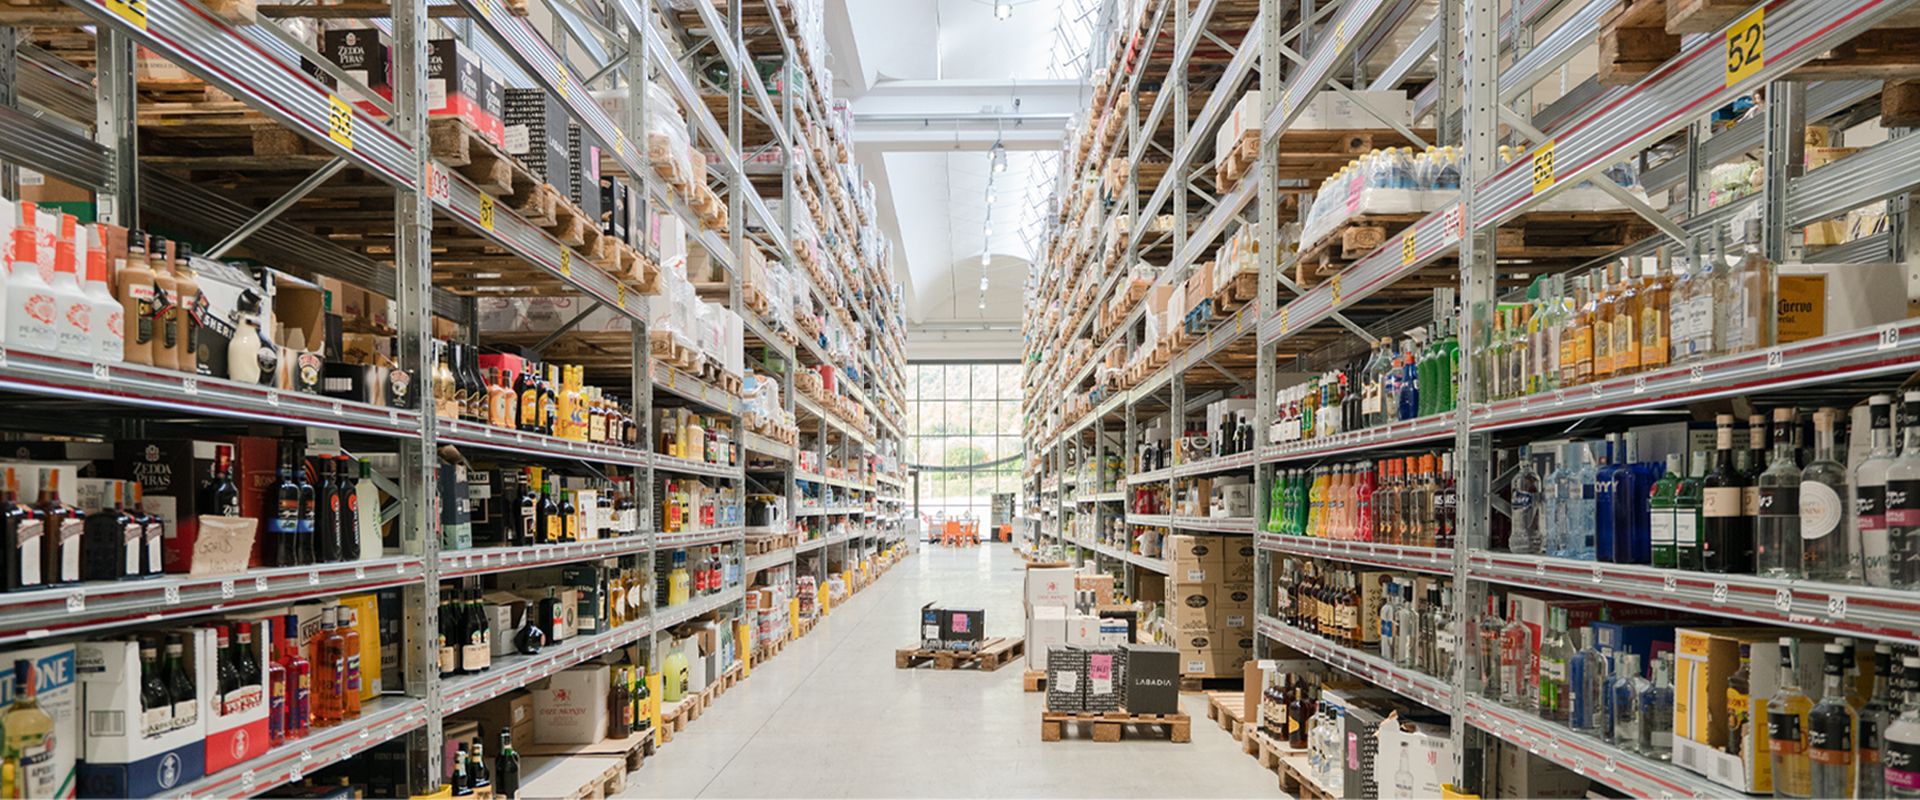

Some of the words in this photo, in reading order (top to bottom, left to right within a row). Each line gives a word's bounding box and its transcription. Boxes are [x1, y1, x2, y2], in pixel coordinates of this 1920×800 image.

[338, 44, 364, 56] ZEDDA
[1728, 23, 1762, 73] 52
[340, 54, 364, 66] PIRAS
[331, 105, 352, 139] 53
[1534, 151, 1554, 184] 53
[1880, 328, 1898, 345] 18
[1769, 351, 1781, 366] 21
[96, 362, 109, 377] 21
[132, 462, 172, 475] ZEDDA
[135, 474, 171, 486] PIRAS
[1714, 584, 1727, 599] 29
[1777, 592, 1790, 607] 04
[1828, 598, 1844, 614] 34
[1136, 678, 1172, 687] LABADIA
